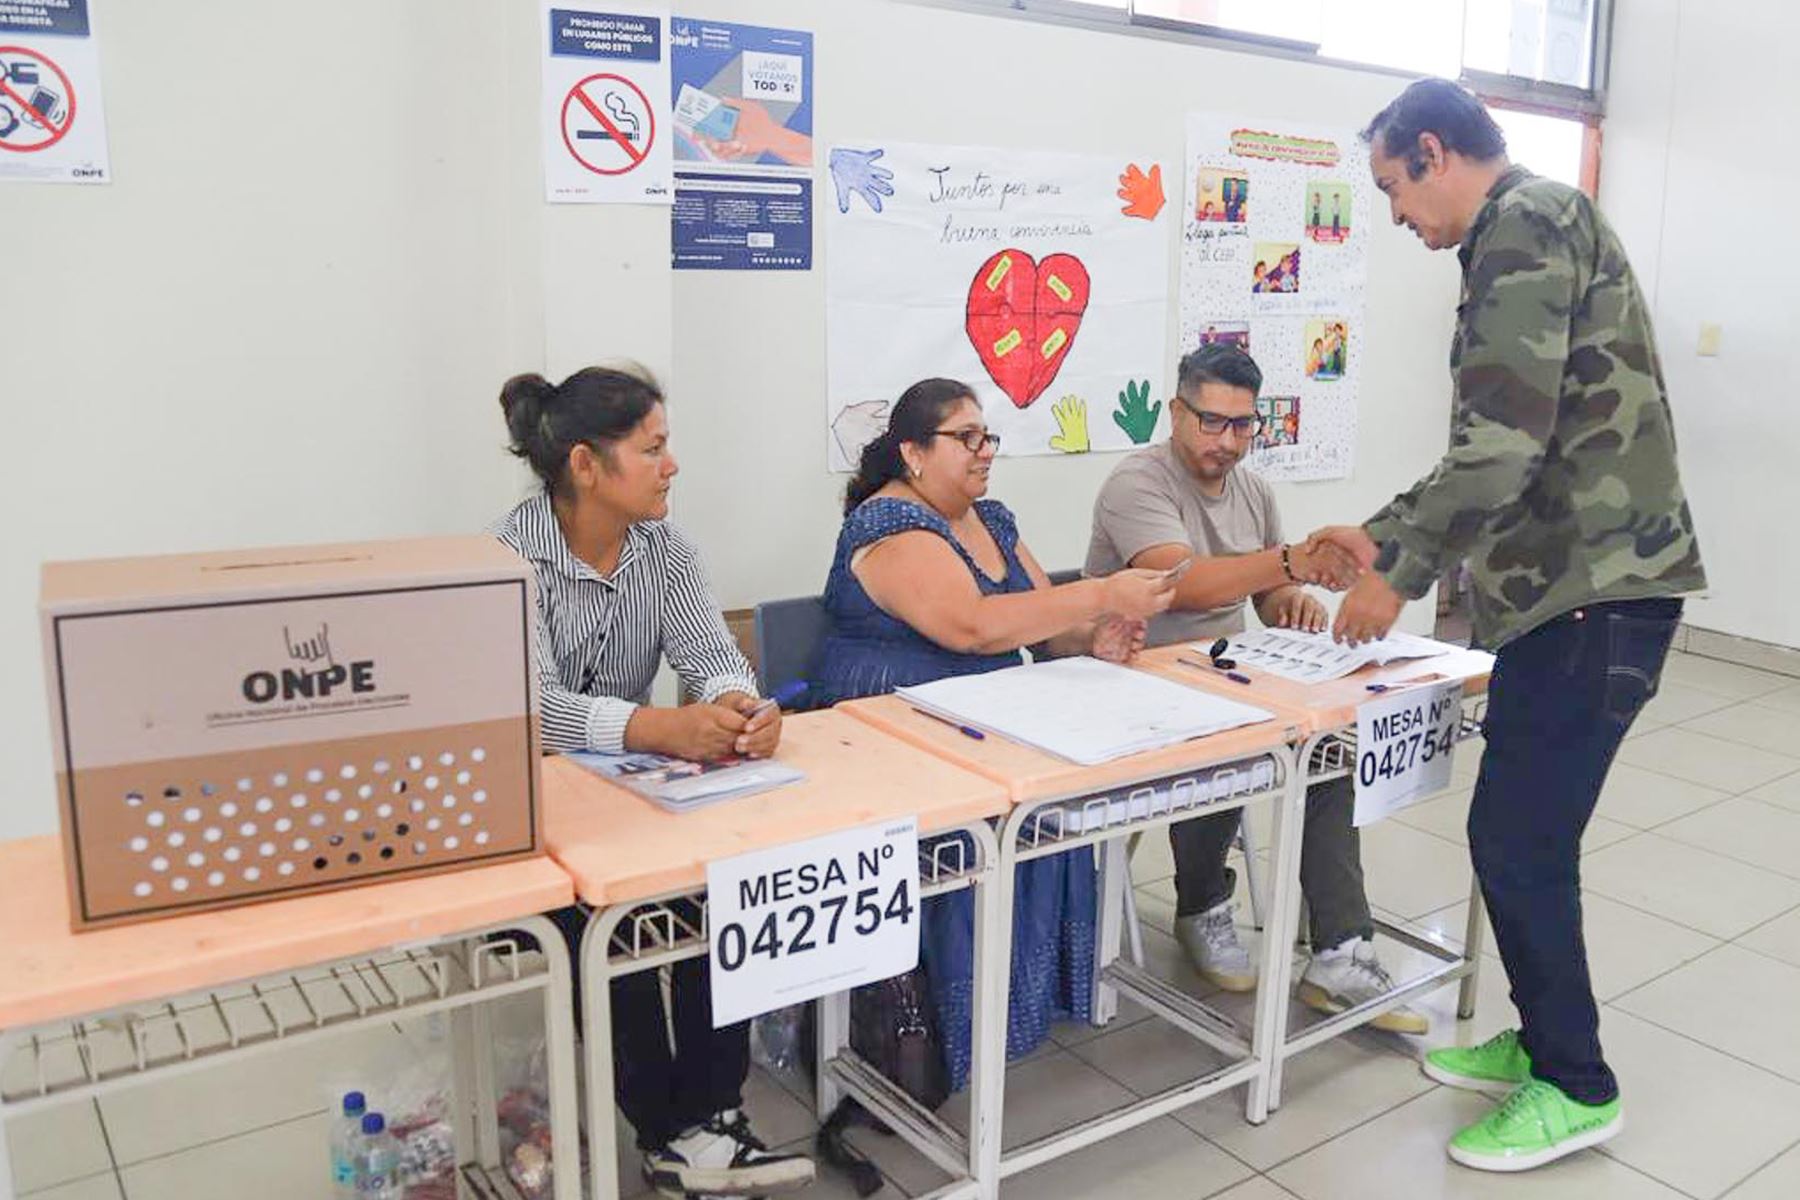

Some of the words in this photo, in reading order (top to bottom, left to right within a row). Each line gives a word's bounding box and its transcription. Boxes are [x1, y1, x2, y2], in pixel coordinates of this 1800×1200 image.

[562, 28, 574, 38] EN
[575, 29, 611, 41] LUGARES
[612, 31, 653, 44] PÚBLICOS
[570, 17, 615, 30] PROHIBIDO
[616, 21, 645, 32] FUMAR
[584, 40, 611, 50] COMO
[612, 42, 632, 53] ESTE
[749, 71, 799, 82] VOTAMOS
[72, 168, 104, 178] ONPE
[928, 166, 994, 203] Juntos
[1000, 182, 1026, 211] por
[940, 213, 999, 243] buena
[242, 660, 376, 704] ONPE
[1372, 704, 1423, 742] MESA
[1360, 723, 1454, 787] 042754
[739, 857, 847, 911] MESA
[717, 878, 914, 972] 042754
